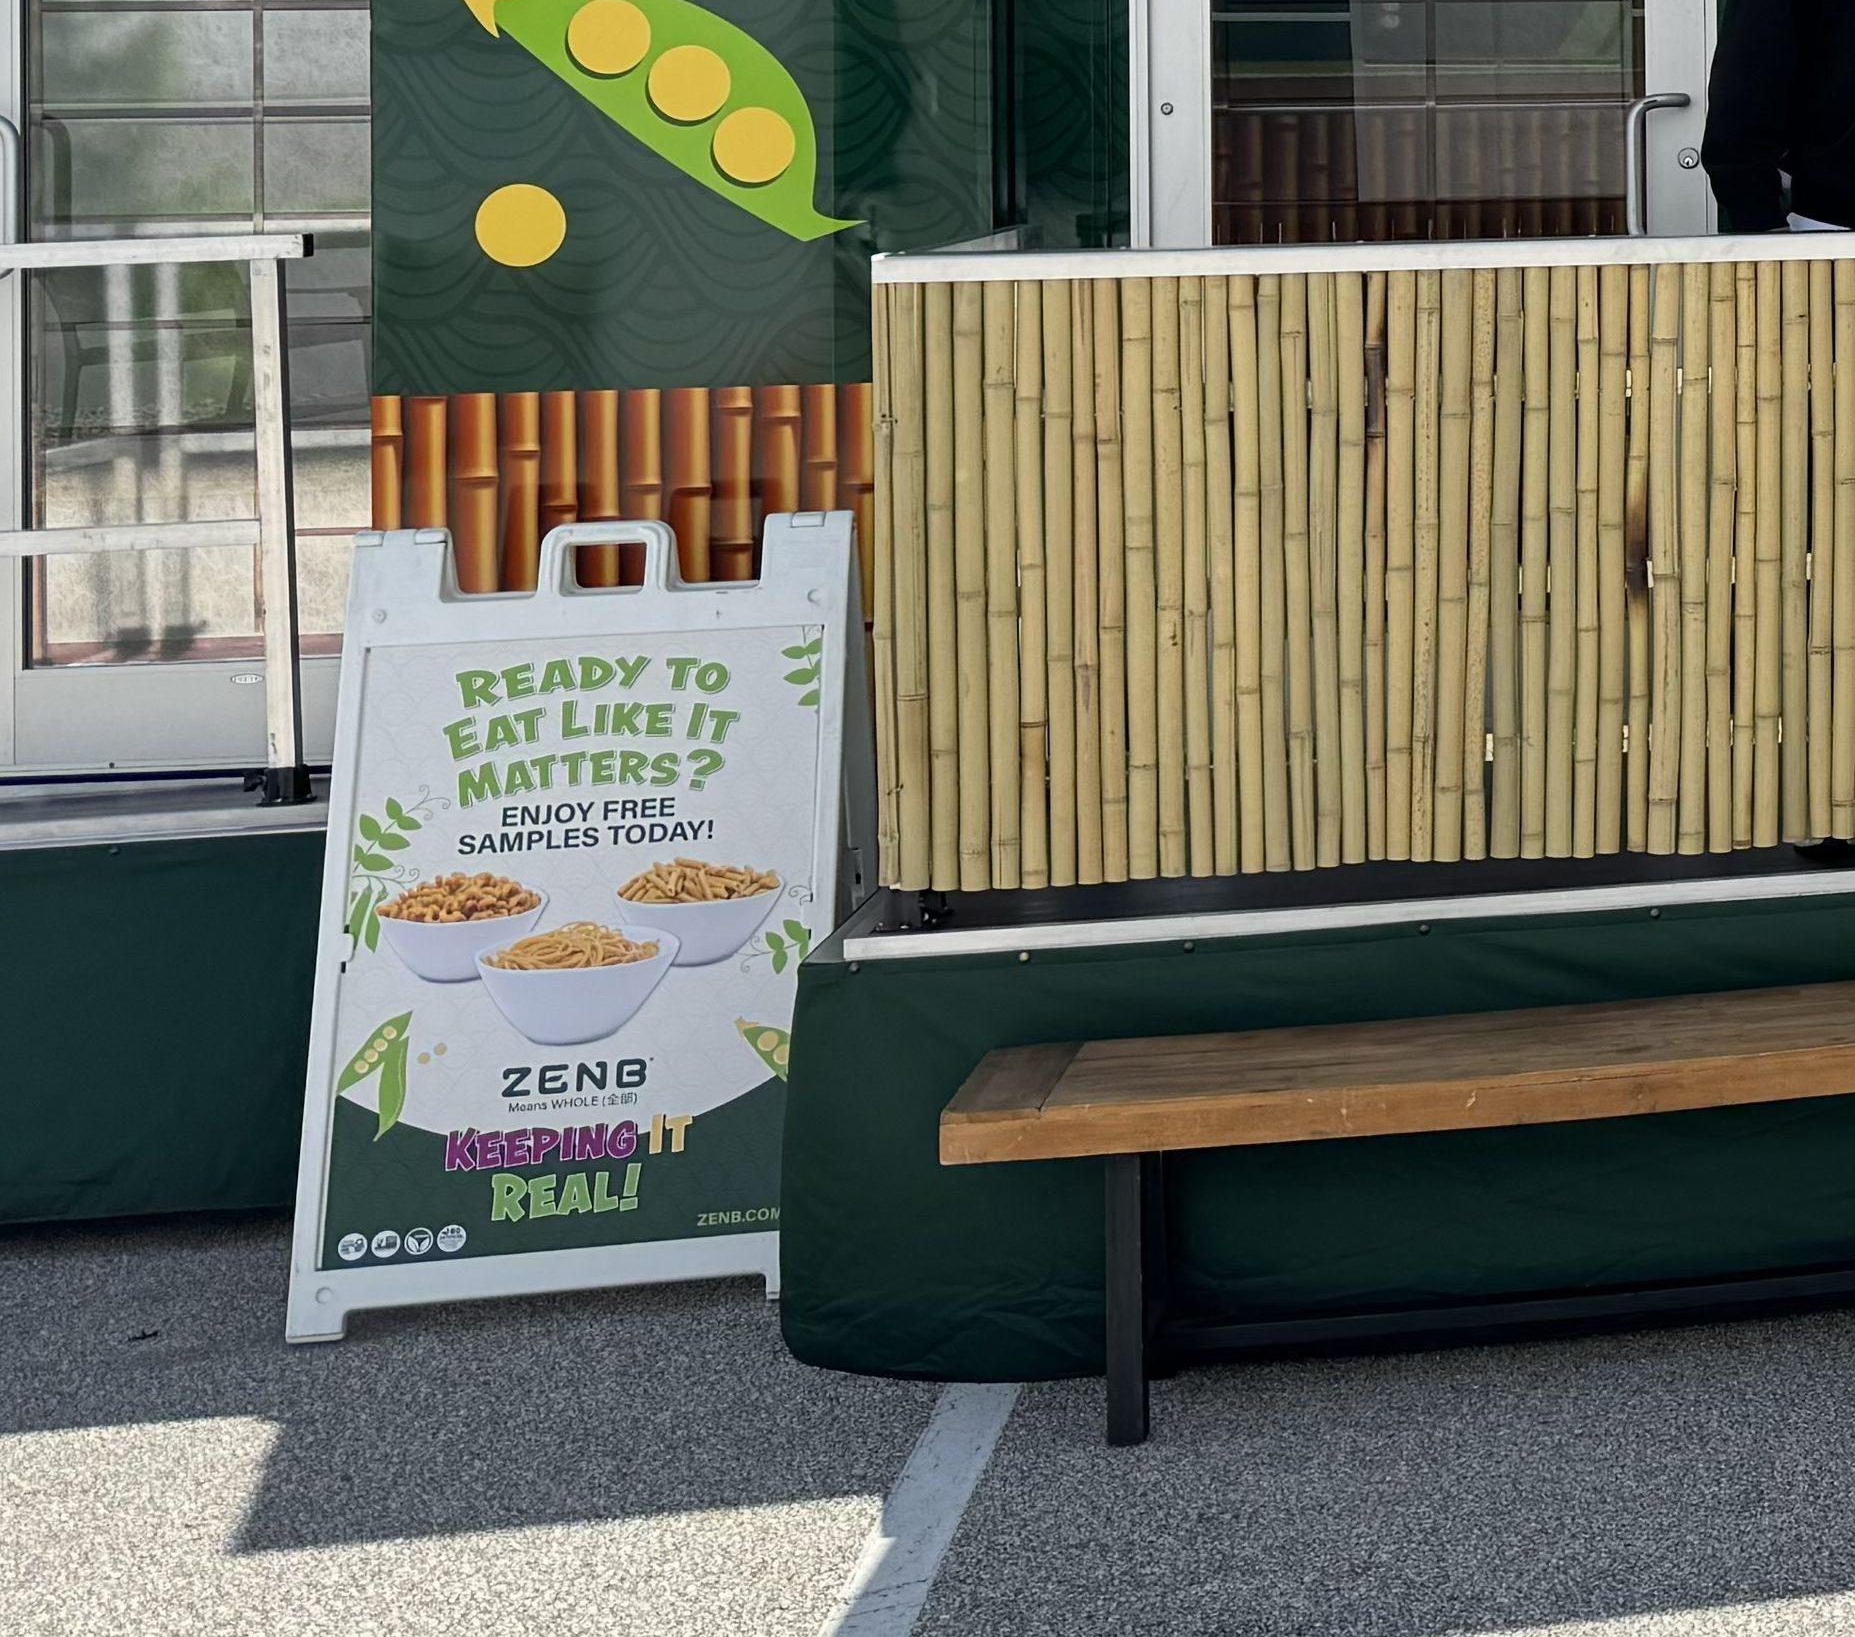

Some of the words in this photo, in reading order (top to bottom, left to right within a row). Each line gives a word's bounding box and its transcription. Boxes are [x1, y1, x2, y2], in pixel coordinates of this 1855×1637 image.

[456, 655, 651, 710] READY
[665, 657, 731, 695] TO
[442, 707, 547, 762] EAT
[560, 700, 677, 742] LIKE
[685, 702, 740, 745] IT
[457, 748, 726, 810] MATTERS?
[457, 828, 600, 856] SAMPLES
[611, 820, 715, 846] TODAY!
[502, 800, 595, 828] ENJOY
[602, 797, 677, 822] FREE
[501, 1058, 647, 1098] ZENB
[508, 1101, 547, 1113] Means
[551, 1095, 599, 1110] WHOLE
[444, 1120, 639, 1172] KEEPING
[650, 1112, 694, 1154] IT
[490, 1162, 643, 1222] REAL!
